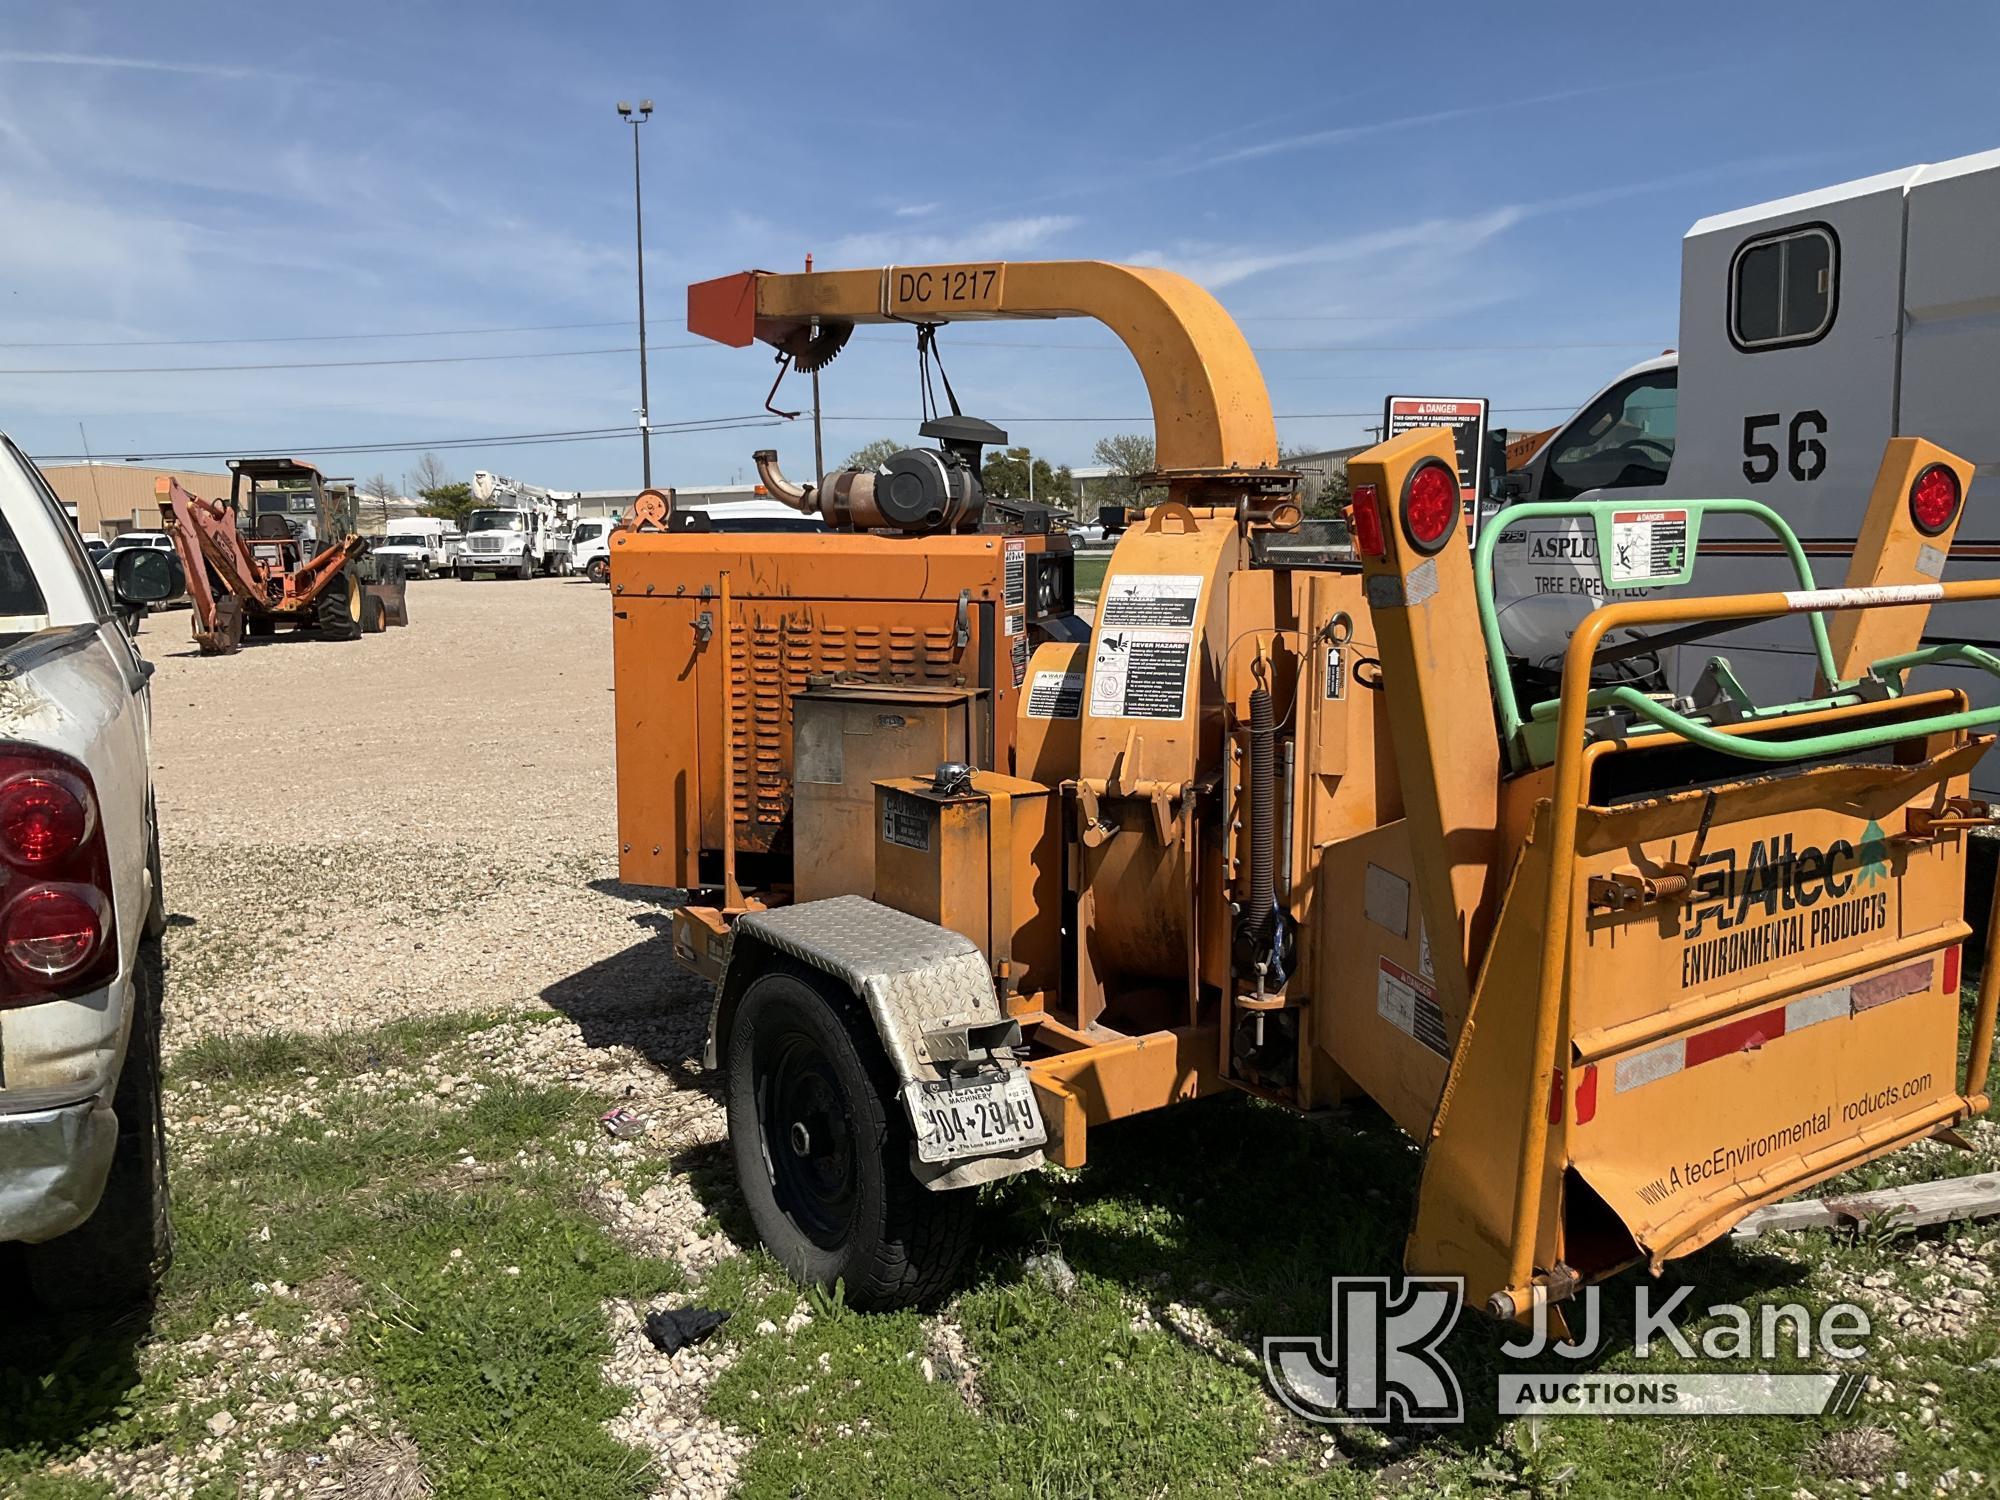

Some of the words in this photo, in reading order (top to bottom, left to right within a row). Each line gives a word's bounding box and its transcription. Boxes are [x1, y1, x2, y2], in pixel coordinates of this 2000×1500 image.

[900, 271, 932, 302] DC
[942, 270, 996, 300] 1217
[1426, 404, 1456, 413] DANGER
[1743, 409, 1827, 484] 56
[1642, 513, 1664, 521] DANGER
[1531, 537, 1599, 558] ASPLU
[1535, 576, 1566, 593] TREE
[1735, 832, 1854, 925] Altec
[1682, 913, 1805, 988] ENVIRONMENTAL
[1810, 892, 1886, 948] PRODUCTS
[1406, 975, 1432, 998] DANGER
[948, 1085, 992, 1098] EXAS
[948, 1092, 992, 1105] MACHINERY
